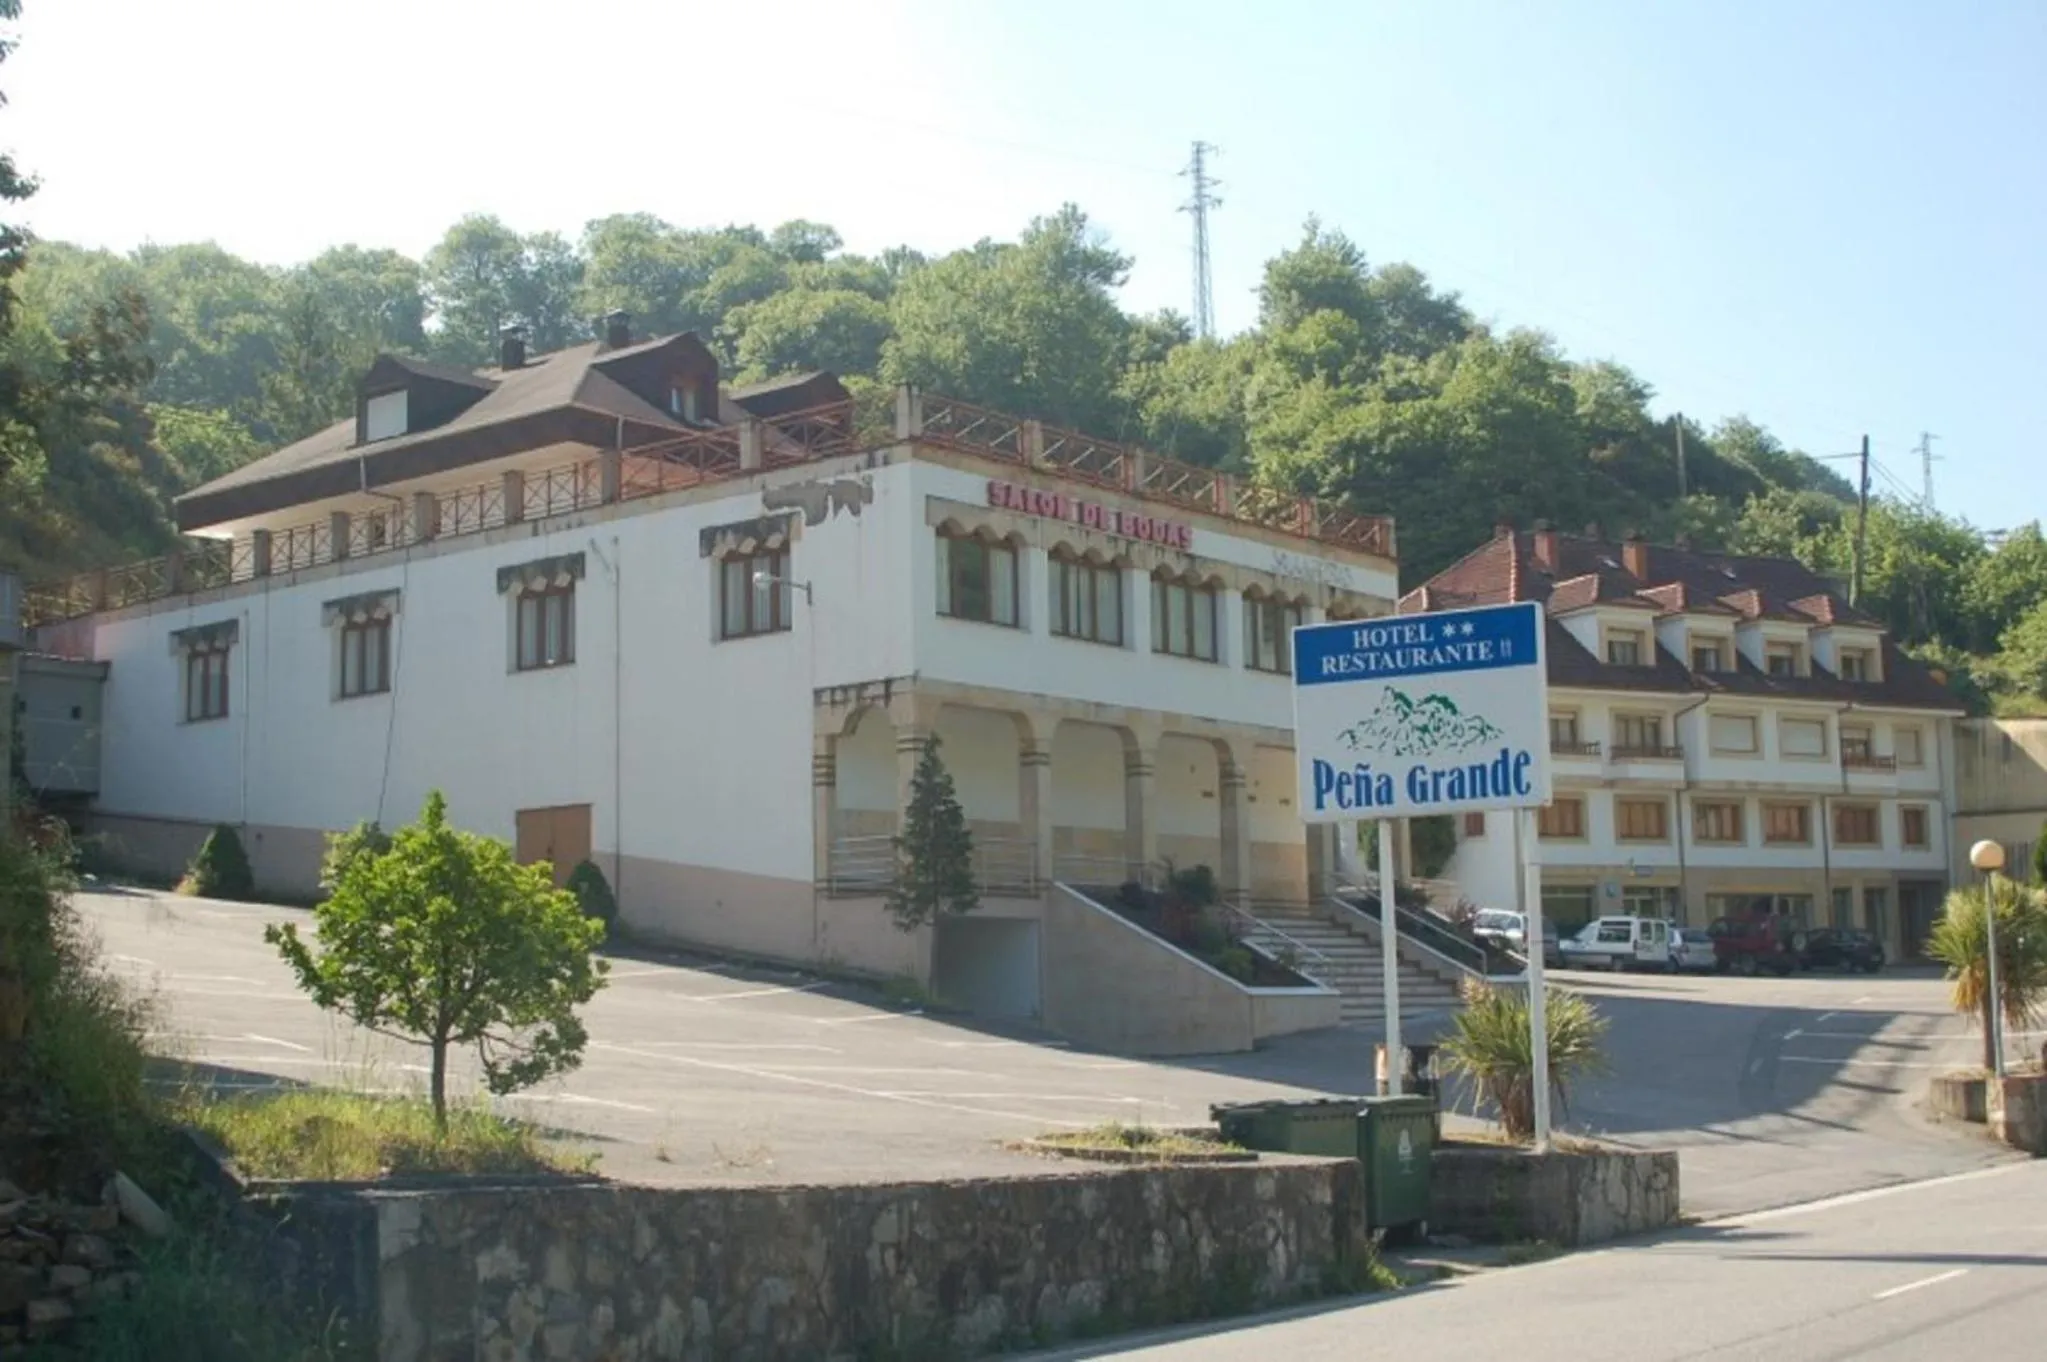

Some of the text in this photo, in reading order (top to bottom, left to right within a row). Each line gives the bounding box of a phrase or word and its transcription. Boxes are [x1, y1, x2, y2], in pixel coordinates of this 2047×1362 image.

[1353, 623, 1435, 649] HOTEL
[1321, 640, 1494, 675] RESTAURANTE
[1313, 748, 1531, 810] Peña Grande
